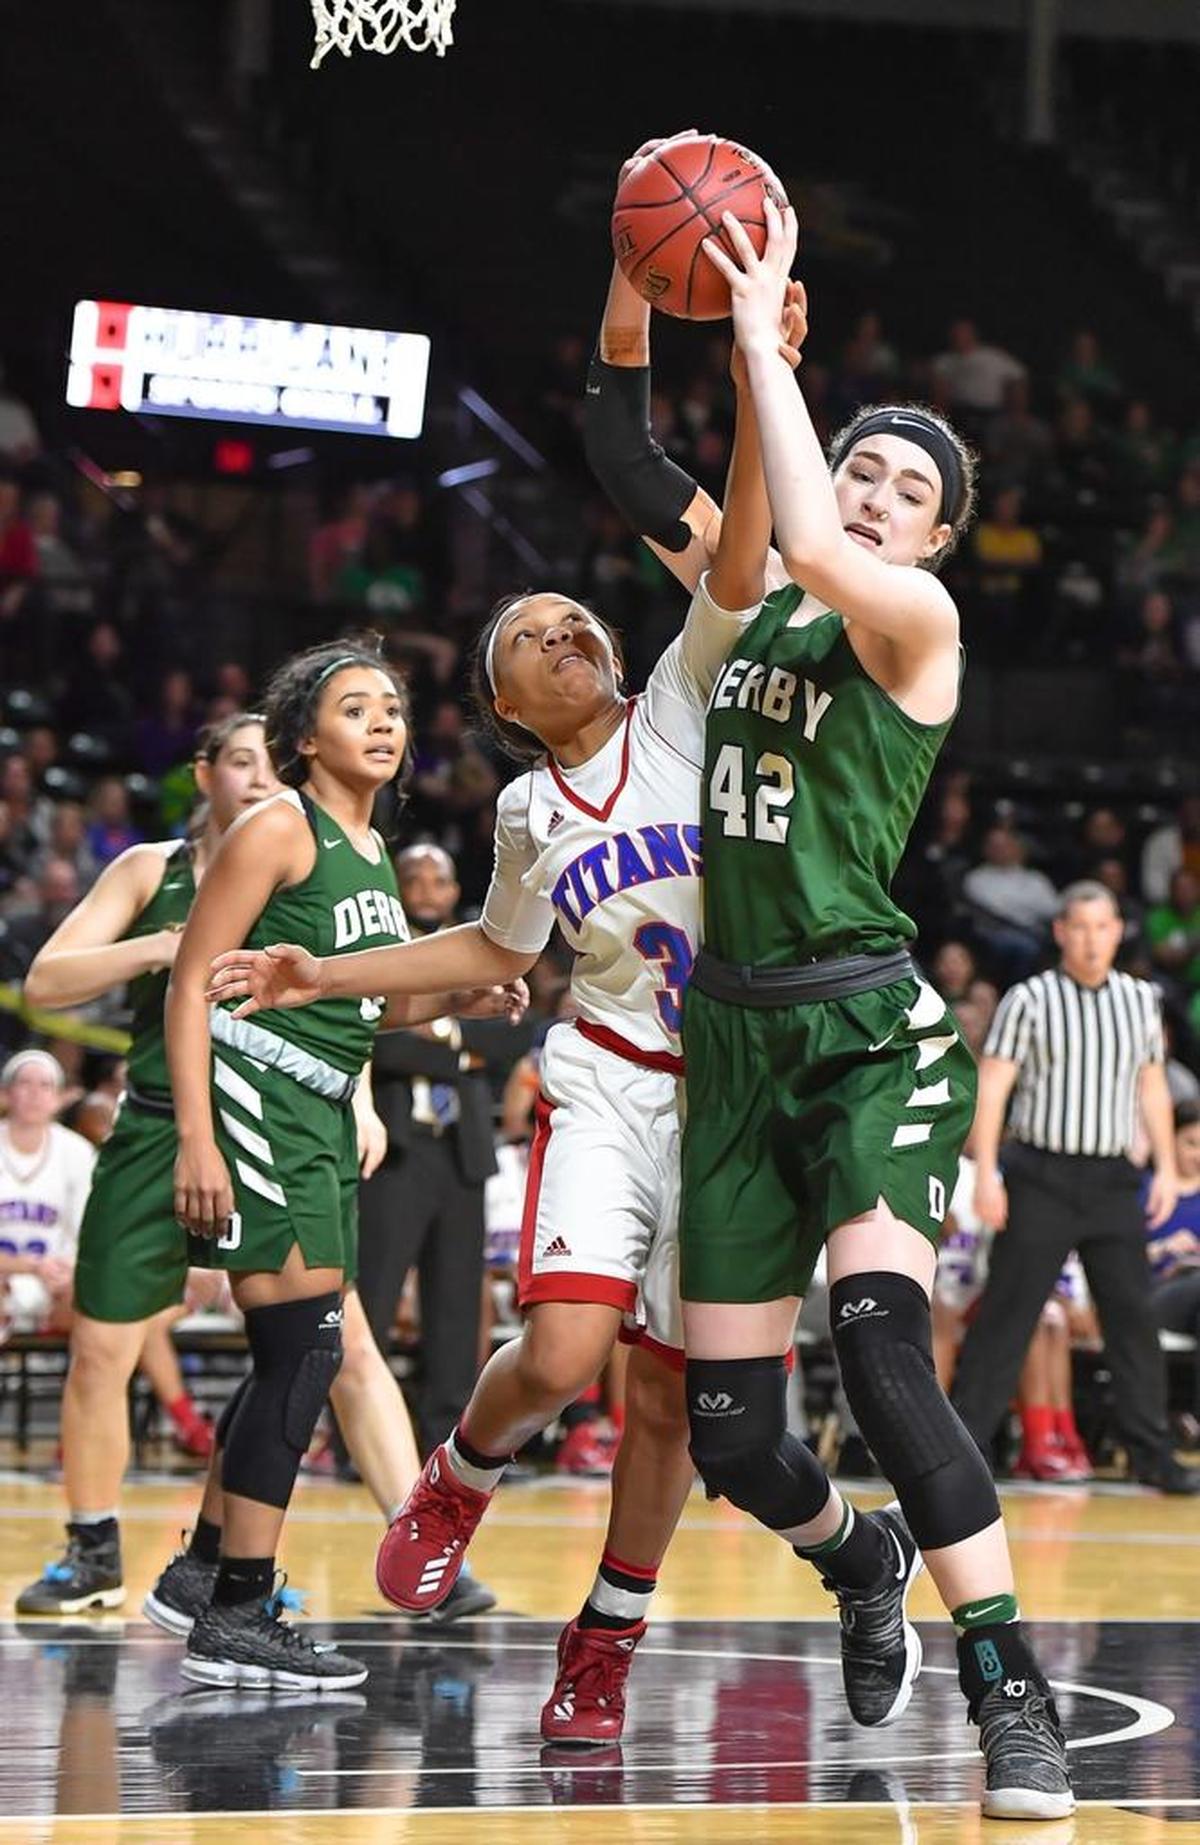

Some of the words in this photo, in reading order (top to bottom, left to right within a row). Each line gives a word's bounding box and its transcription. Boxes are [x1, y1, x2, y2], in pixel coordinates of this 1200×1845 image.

[706, 659, 833, 742] ERBY
[709, 743, 795, 844] 42
[333, 889, 413, 949] DERB
[928, 1174, 946, 1223] D
